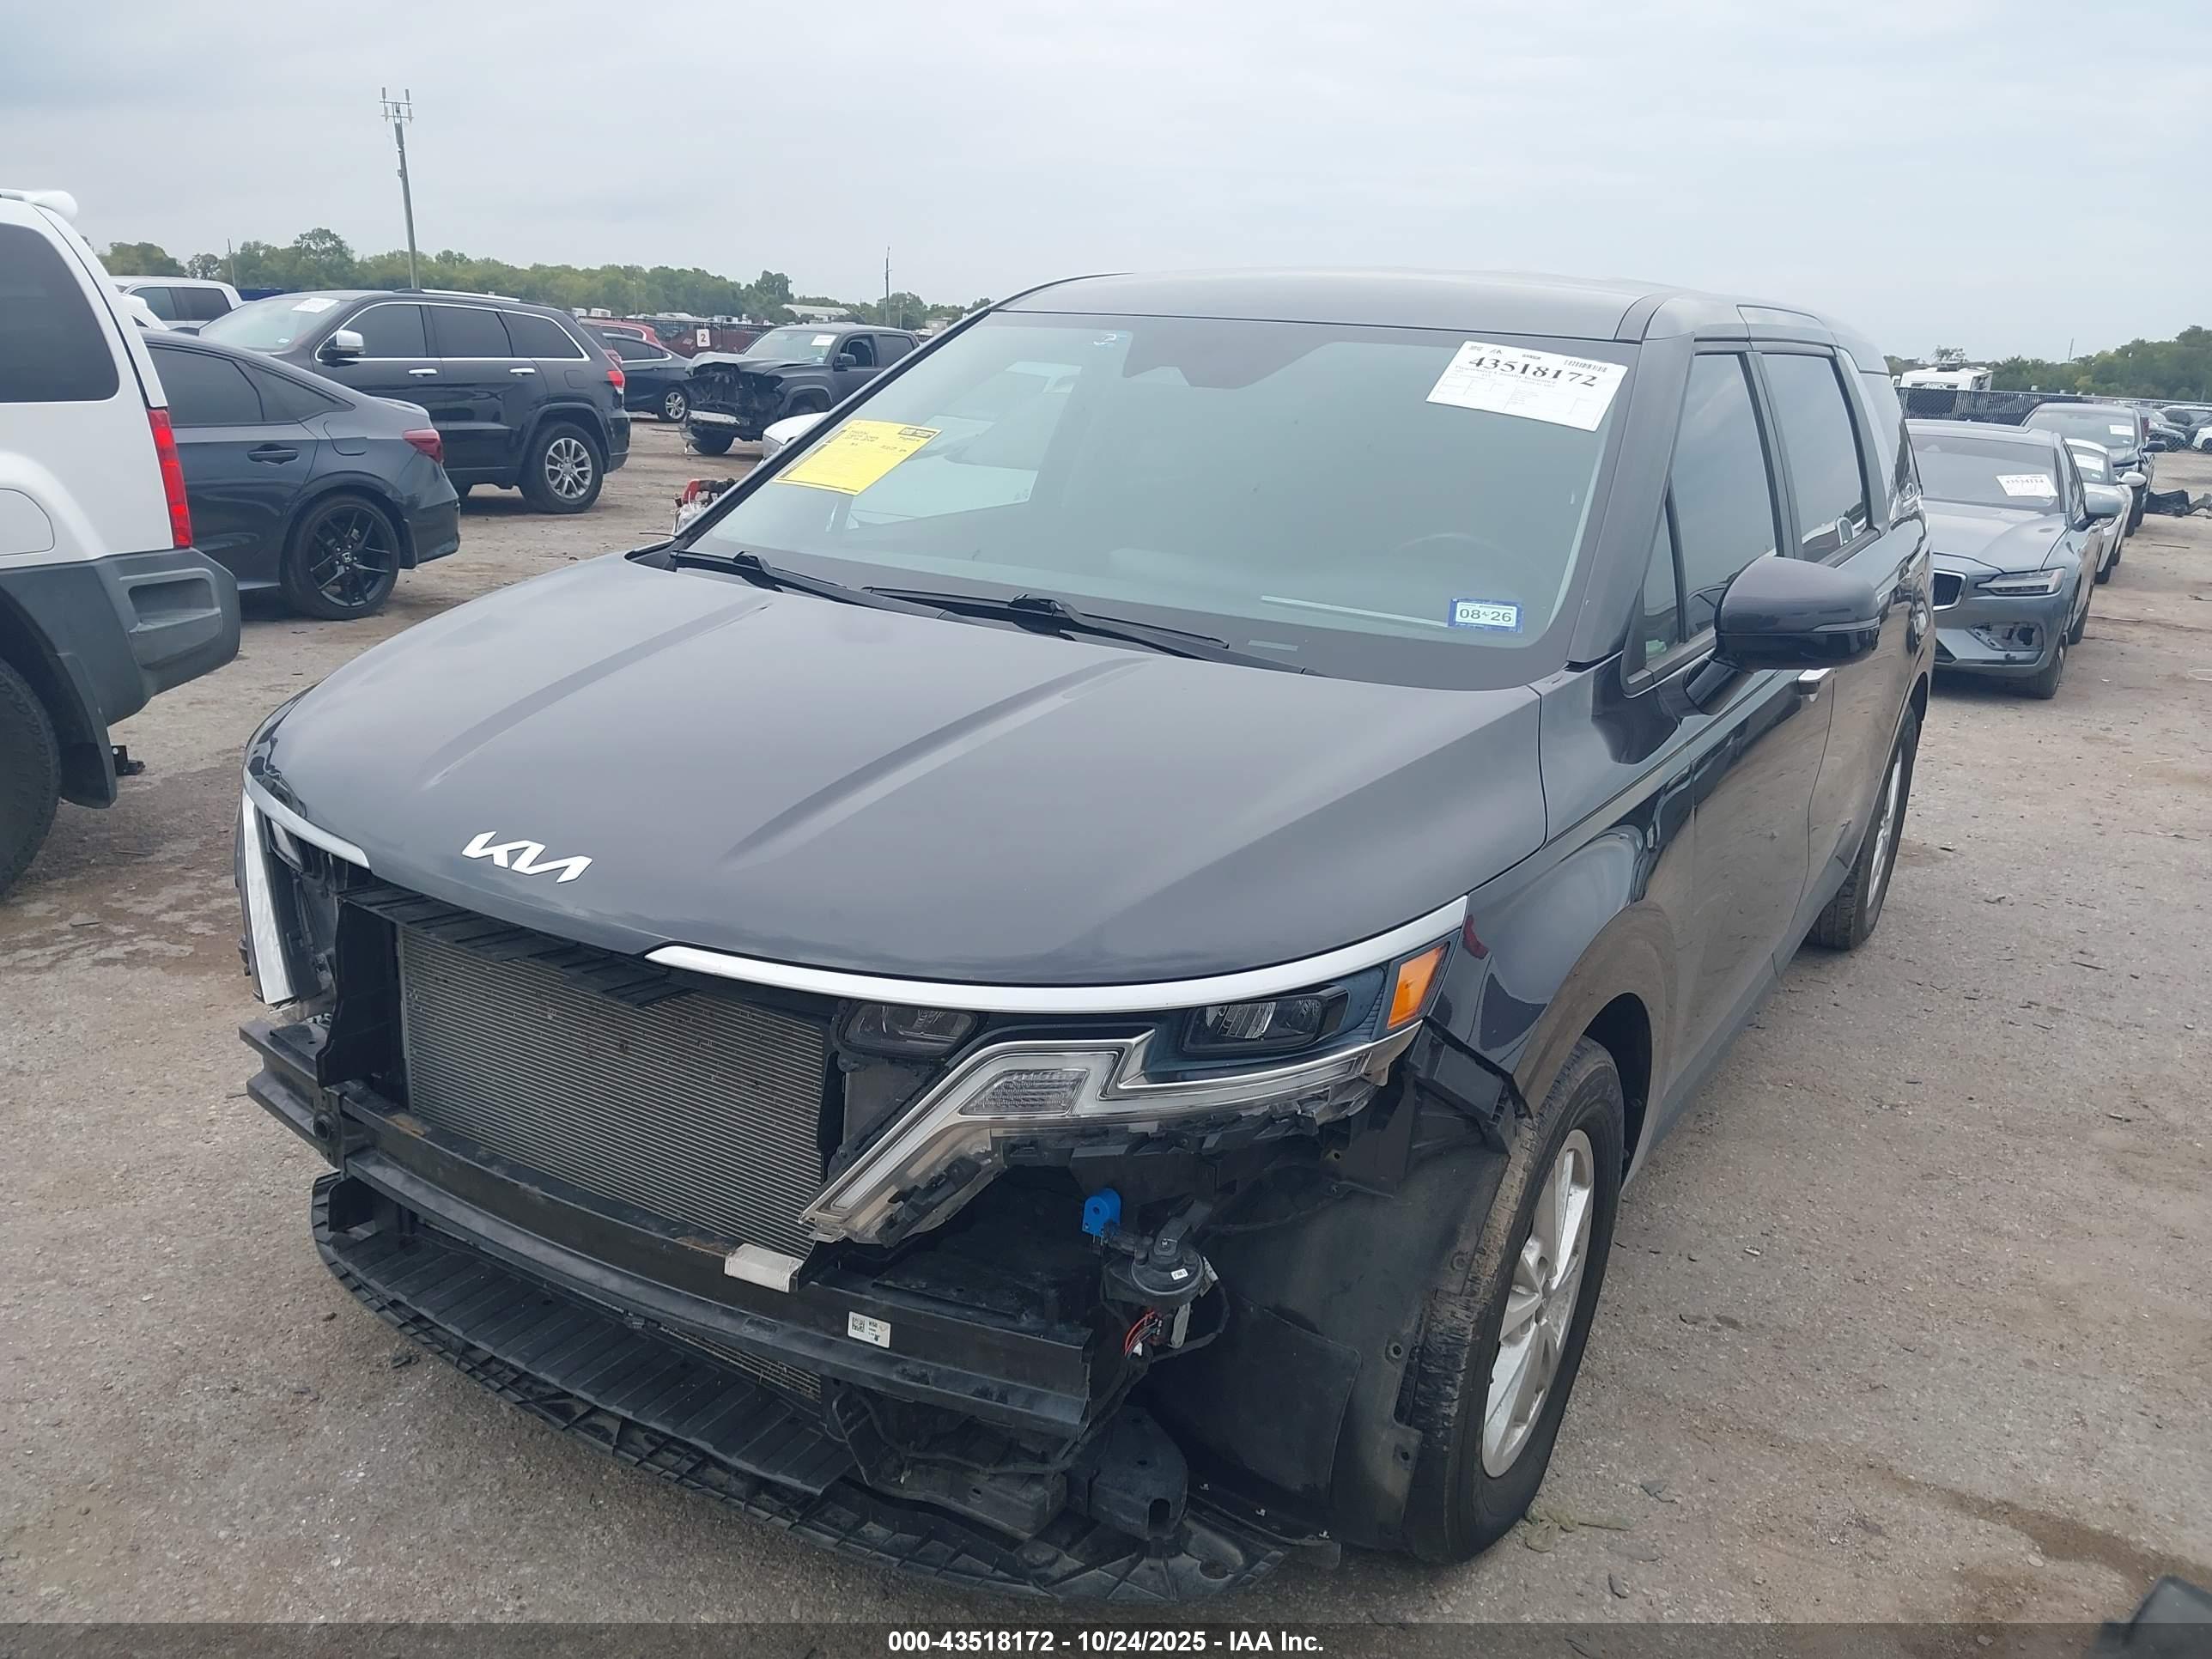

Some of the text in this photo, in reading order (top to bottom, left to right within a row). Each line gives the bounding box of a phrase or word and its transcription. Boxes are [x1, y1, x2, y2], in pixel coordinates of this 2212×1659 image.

[700, 333, 707, 343] 2
[1468, 356, 1597, 386] 43518172
[1460, 608, 1512, 623] 08 26
